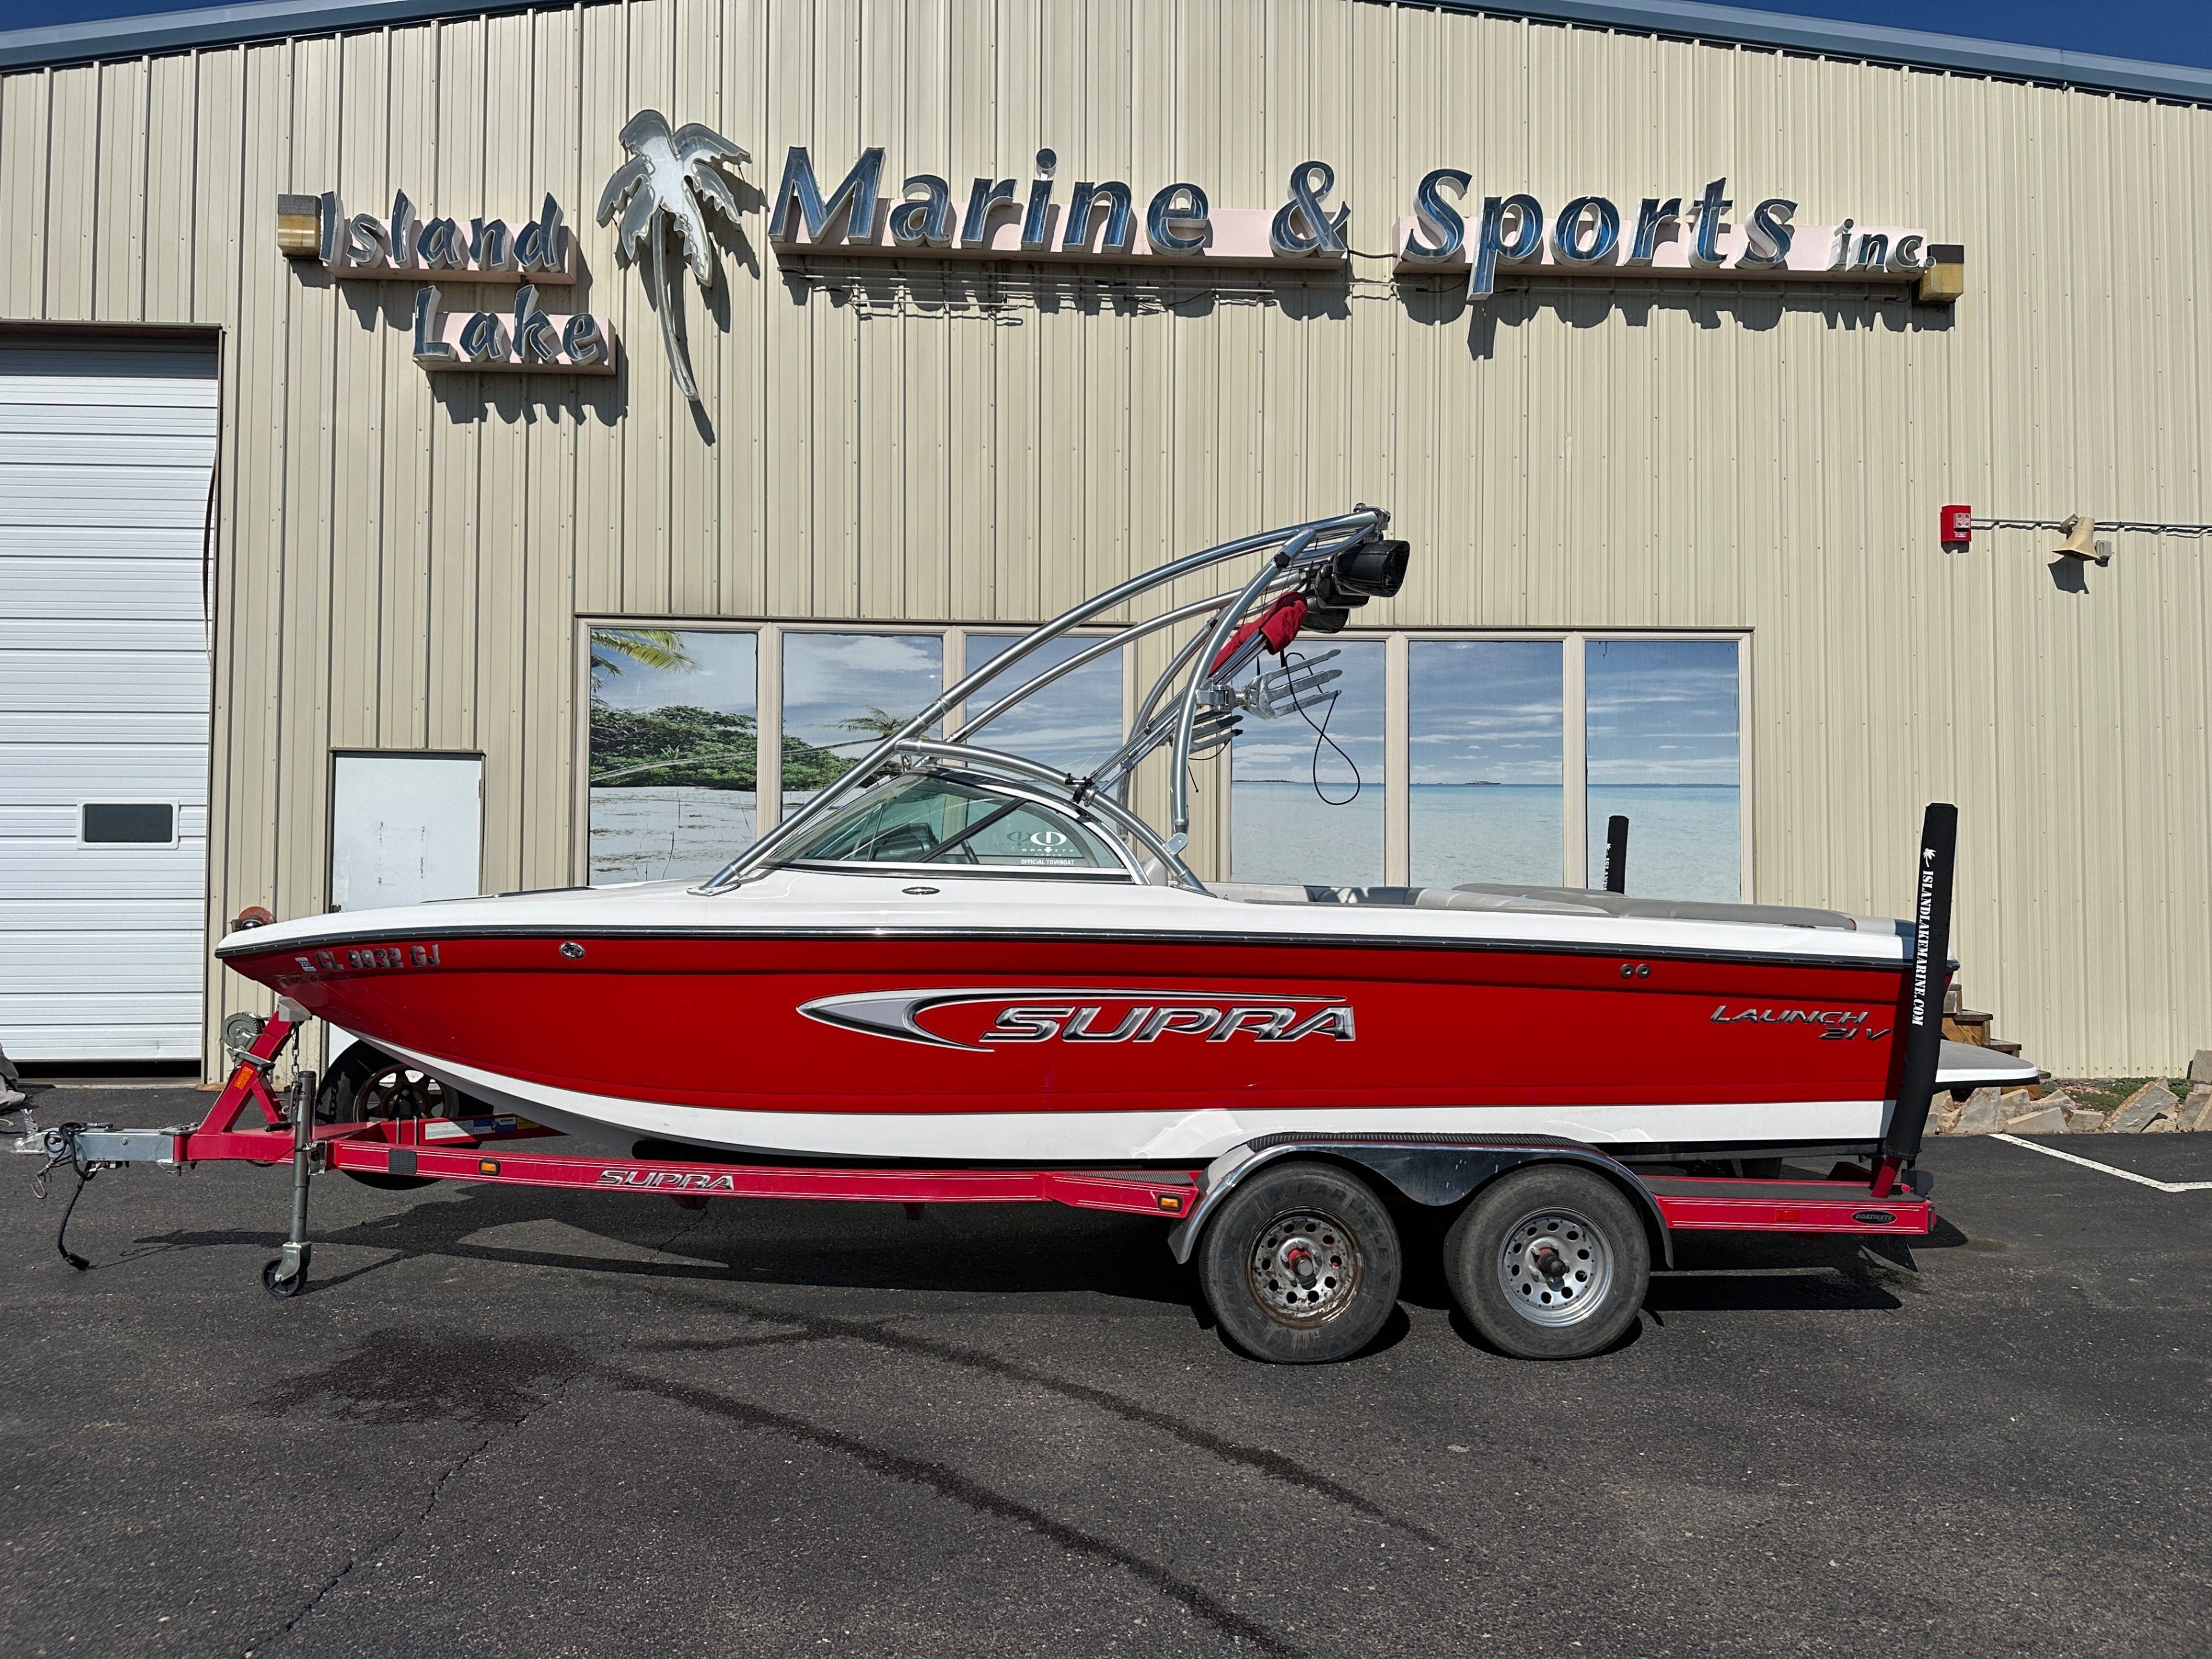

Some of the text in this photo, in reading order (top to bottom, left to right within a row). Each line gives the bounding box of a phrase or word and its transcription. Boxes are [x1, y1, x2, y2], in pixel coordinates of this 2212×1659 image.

[319, 189, 563, 270] Island
[768, 145, 1937, 300] Marine & Sports inc.
[413, 284, 600, 365] Lake
[316, 944, 441, 971] CL 9932 GJ
[1912, 870, 1934, 1027] ISLANDLAKEMARINE.COM
[978, 1004, 1357, 1043] SUPRA
[1709, 1005, 1870, 1025] LAUNCH
[595, 1169, 734, 1191] SUPRA
